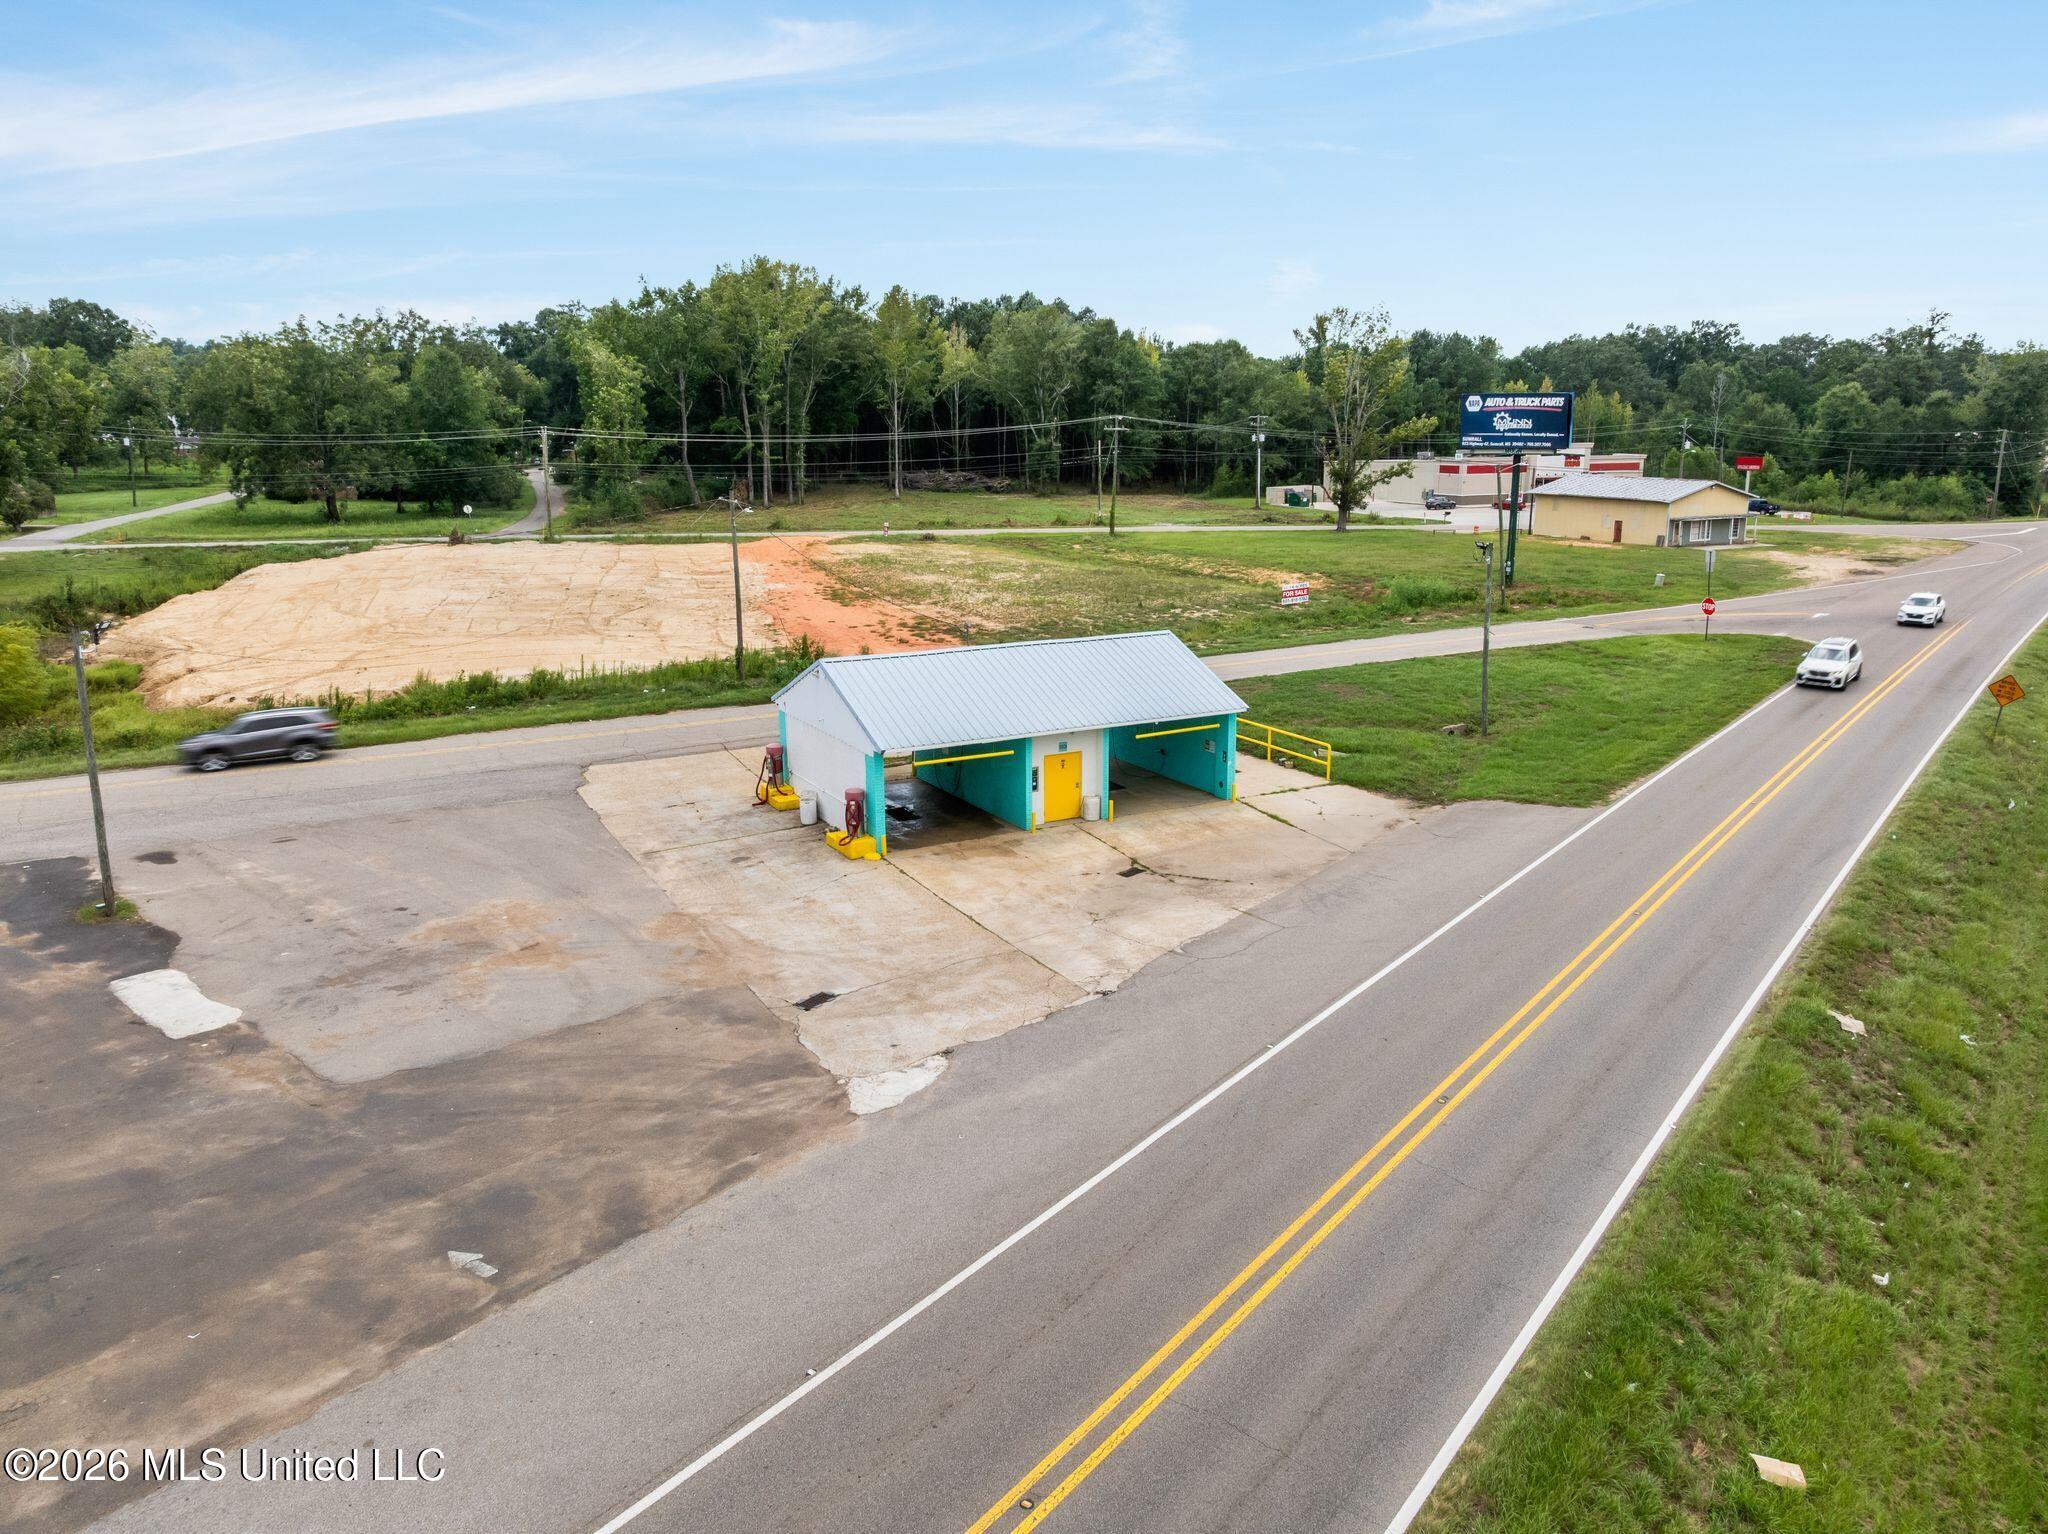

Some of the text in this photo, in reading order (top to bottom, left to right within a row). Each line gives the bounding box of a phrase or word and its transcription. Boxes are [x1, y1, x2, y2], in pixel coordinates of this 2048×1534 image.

[1484, 397, 1506, 407] AUTO
[1506, 397, 1514, 407] &
[1514, 397, 1541, 407] TRUCK
[1541, 397, 1565, 407] PARTS
[1702, 602, 1715, 610] STOP
